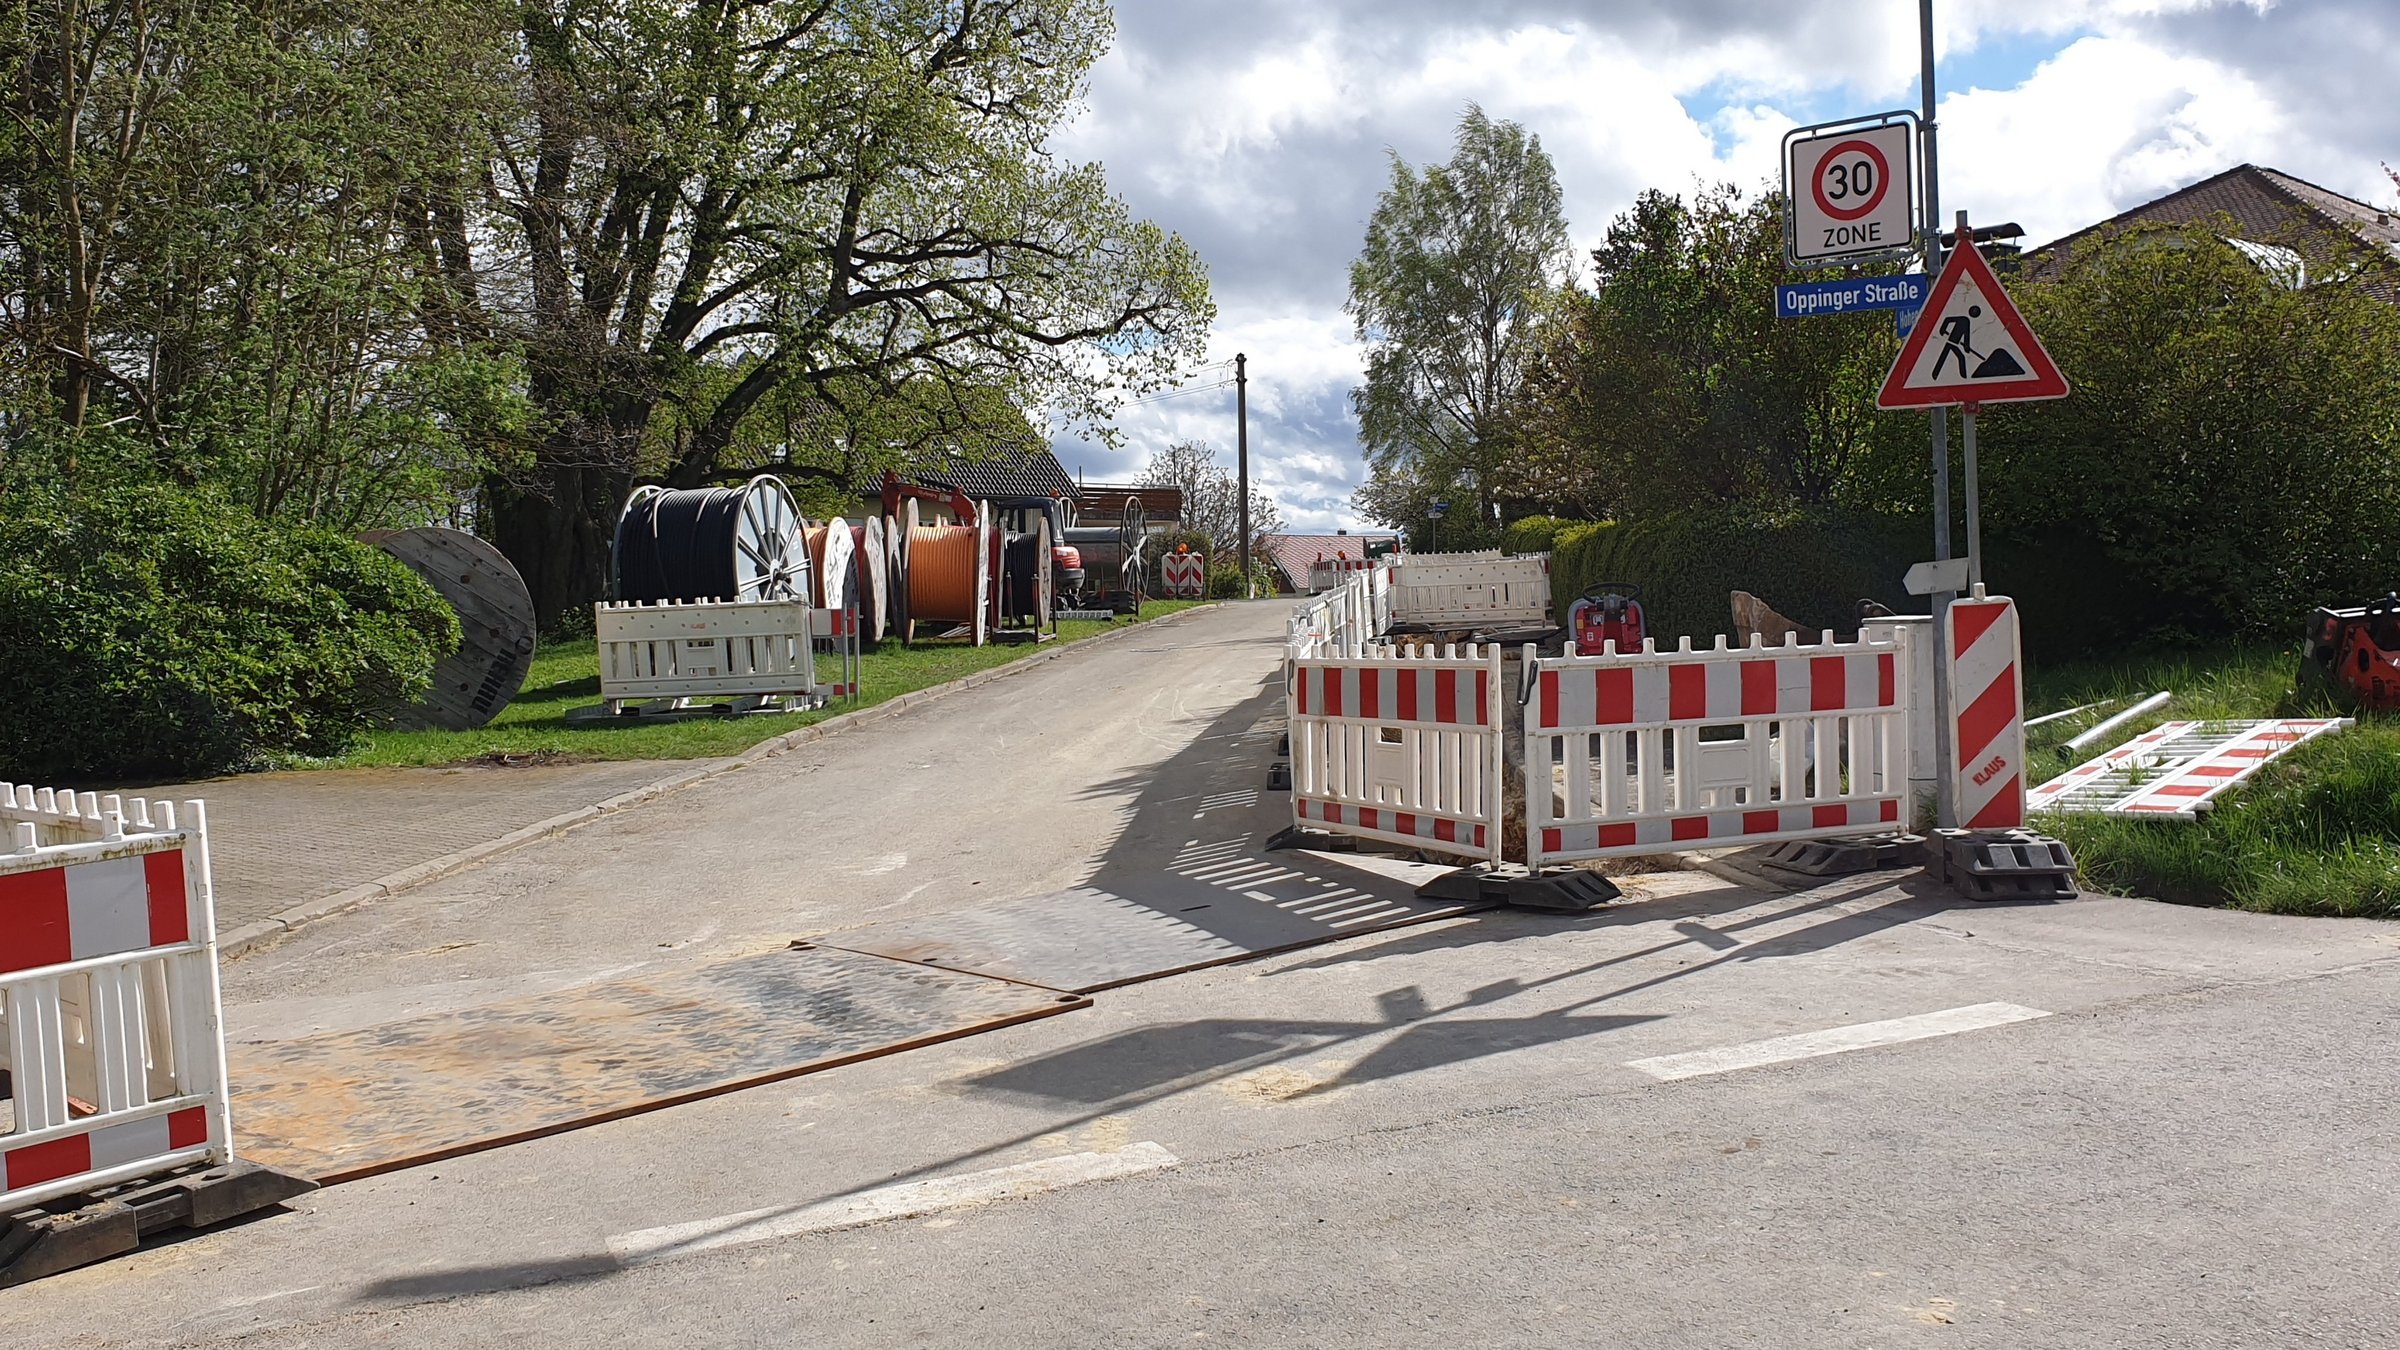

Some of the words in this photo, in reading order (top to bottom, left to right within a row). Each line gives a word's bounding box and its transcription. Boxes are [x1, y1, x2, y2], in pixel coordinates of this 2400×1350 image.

[1828, 161, 1872, 199] 30
[1823, 222, 1881, 248] ZONE
[1786, 288, 1860, 314] Oppinger
[1865, 281, 1919, 303] Straße
[1972, 755, 2006, 786] KLAUS
